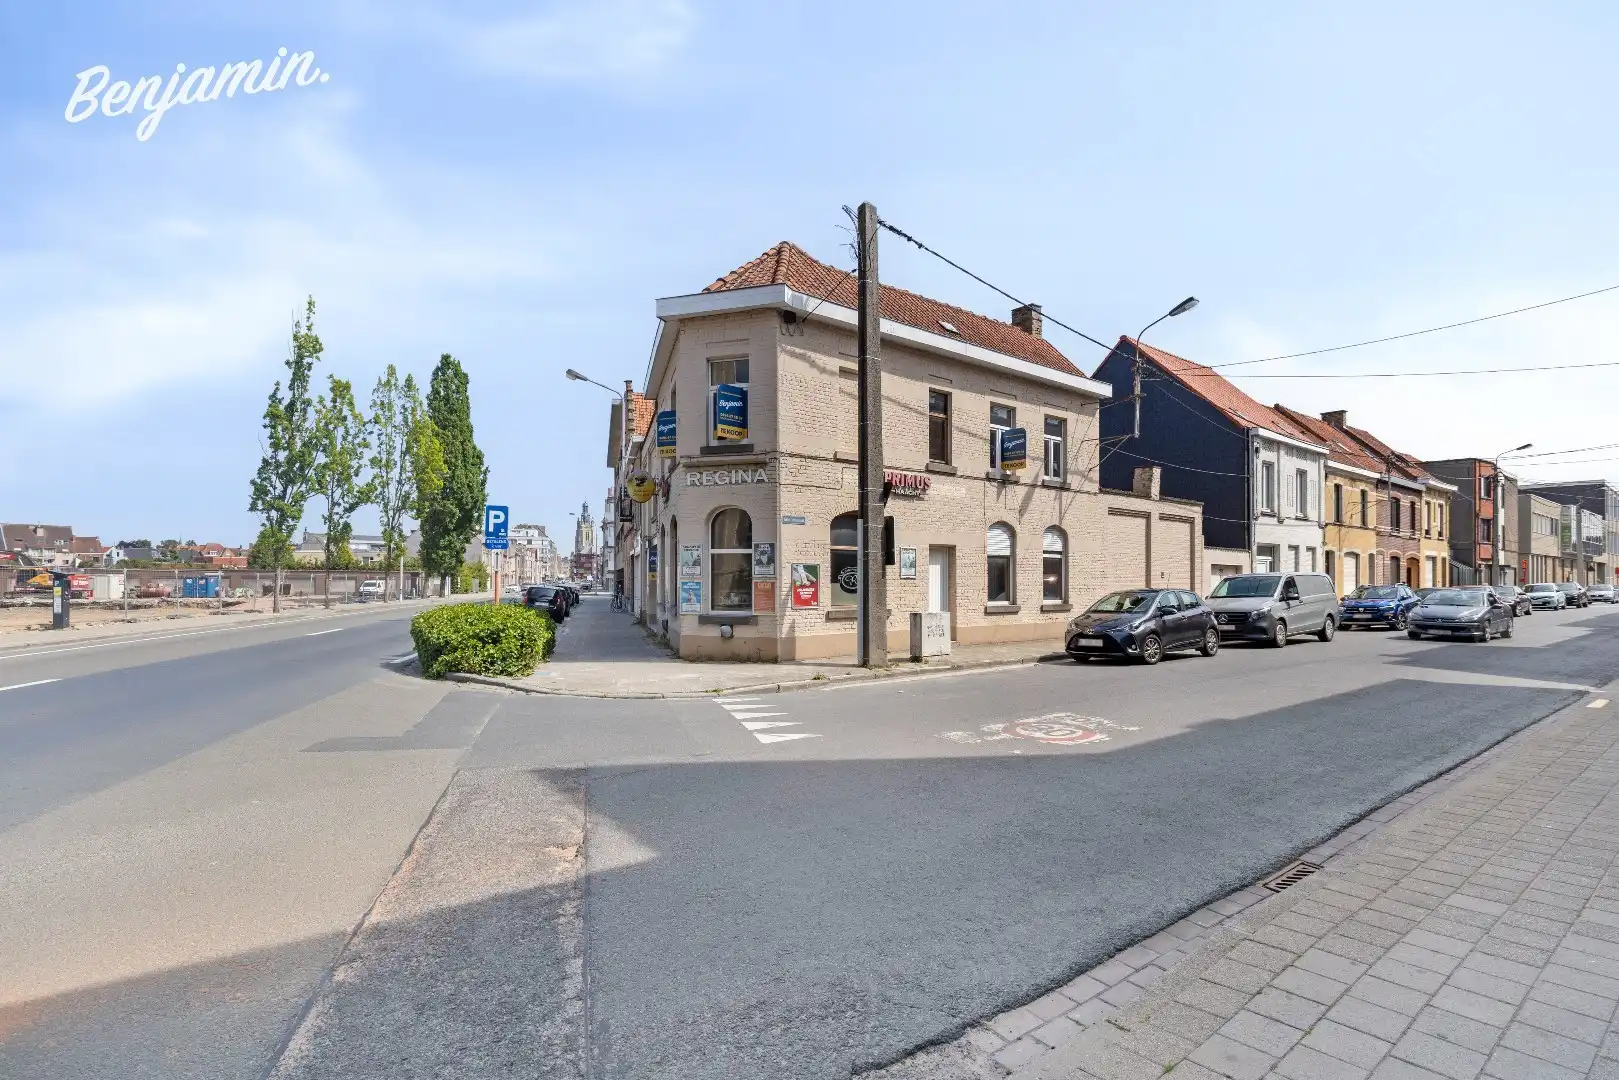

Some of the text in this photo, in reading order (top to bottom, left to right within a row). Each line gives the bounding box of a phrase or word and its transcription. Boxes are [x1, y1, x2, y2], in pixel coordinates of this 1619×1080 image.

[726, 429, 743, 437] KOOP
[686, 468, 769, 486] REGINA
[884, 471, 932, 490] PRIMUS
[488, 510, 505, 532] P
